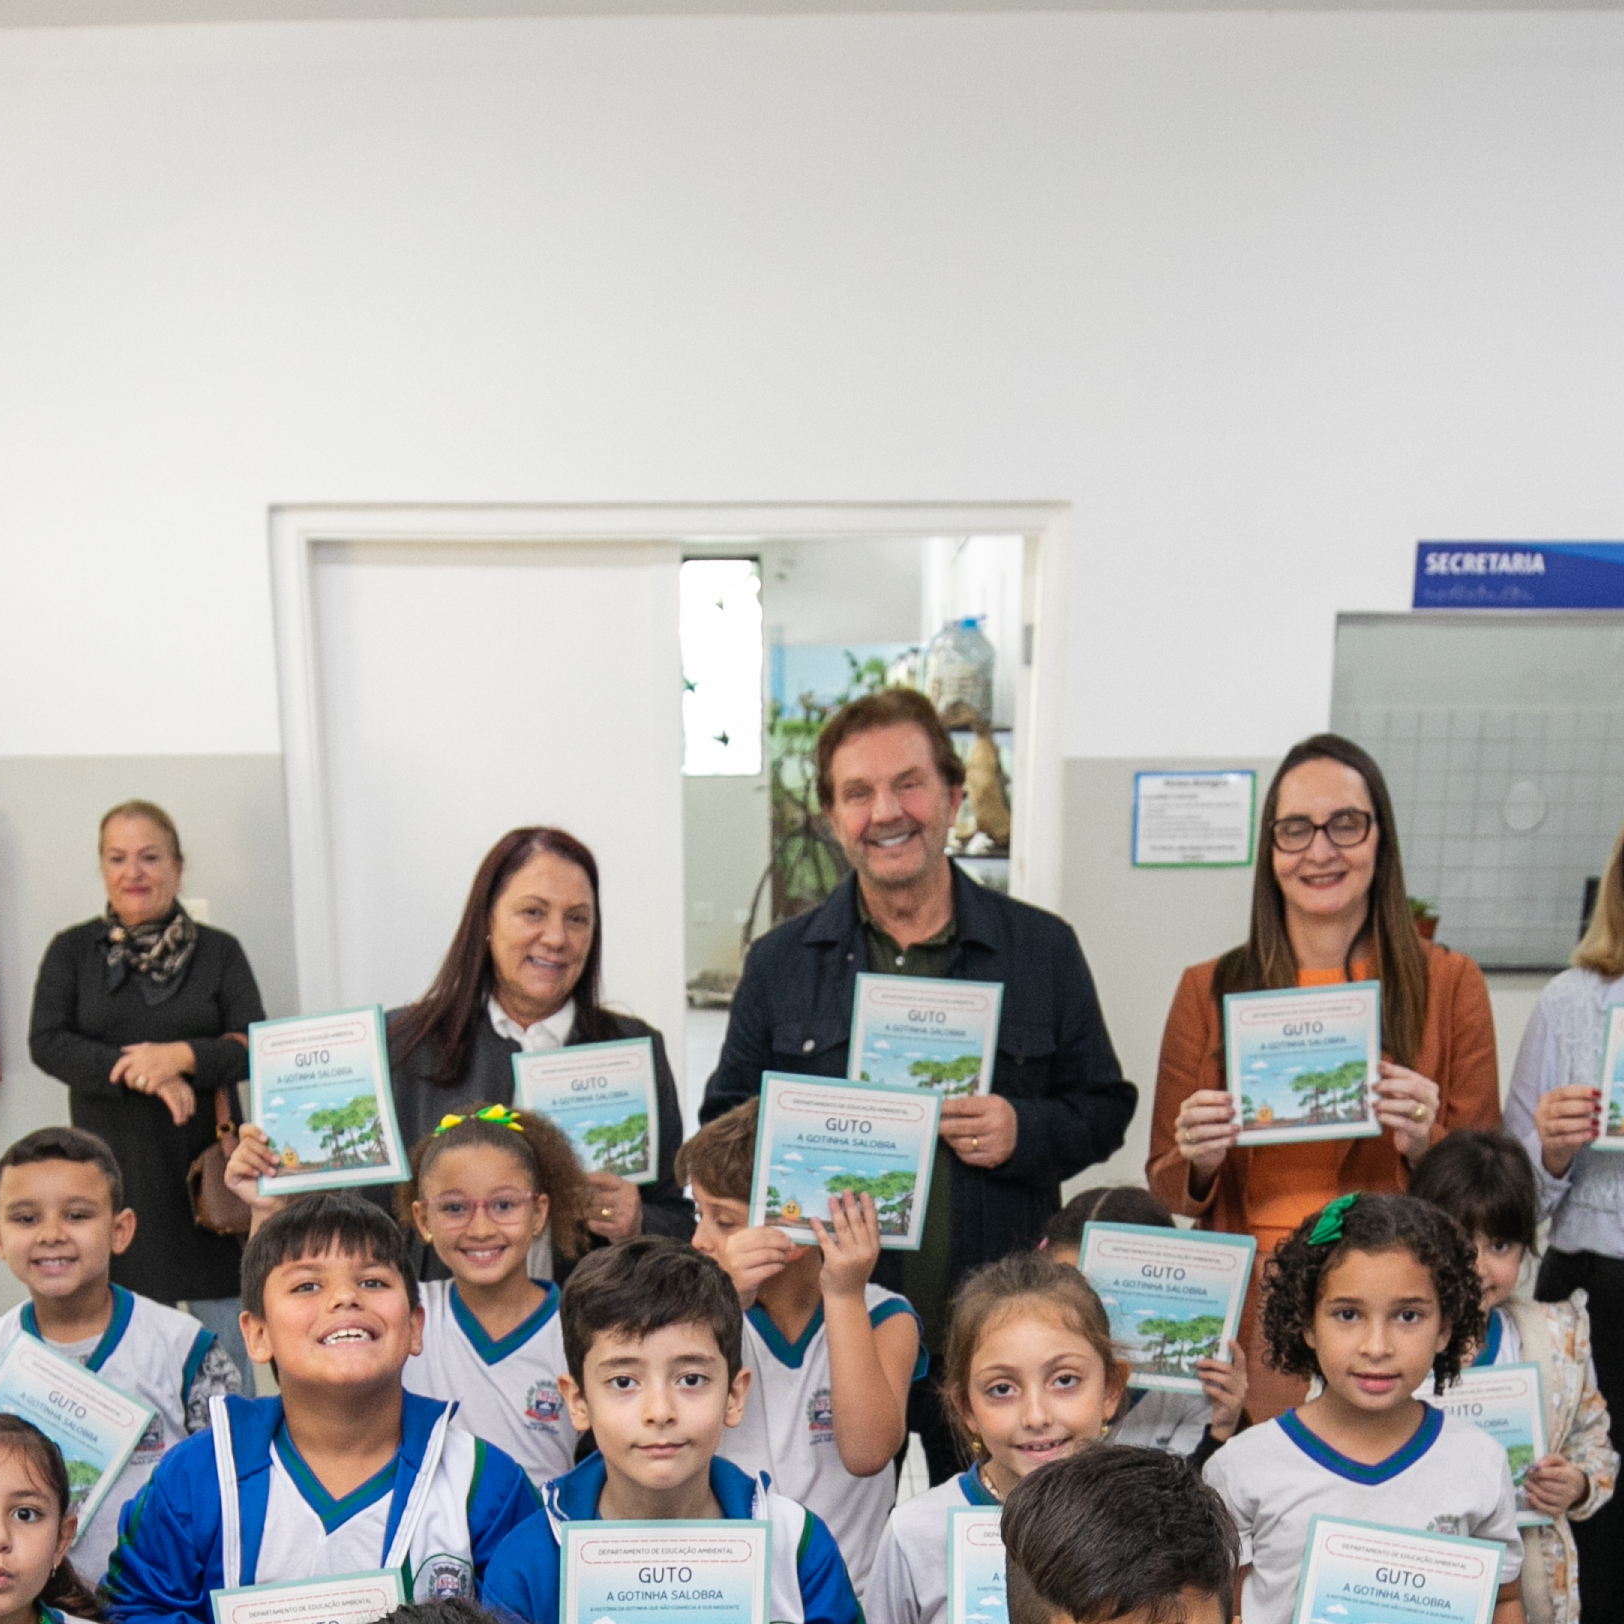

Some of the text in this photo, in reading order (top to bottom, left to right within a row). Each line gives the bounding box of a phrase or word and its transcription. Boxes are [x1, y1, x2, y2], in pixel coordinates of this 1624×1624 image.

[1424, 552, 1546, 576] SECRETARIA
[908, 1010, 946, 1023] GUTO
[1283, 1022, 1323, 1036] GUTO
[295, 1050, 330, 1067] GUTO
[571, 1077, 607, 1091] GUTO
[826, 1118, 871, 1134] GUTO
[1142, 1265, 1185, 1280] GUTO
[49, 1391, 86, 1418] GUTO
[661, 1546, 697, 1555] EDUCAÇÃO
[639, 1567, 692, 1583] GUTO
[1376, 1568, 1425, 1588] GUTO
[606, 1590, 723, 1601] A GOTINHA SALOBRA
[1343, 1583, 1450, 1609] A GOTINHA SALOBRA
[249, 1607, 298, 1618] DEPARTAMENTO
[308, 1600, 341, 1611] EDUCAÇÃO
[342, 1597, 375, 1606] AMBIENTAL
